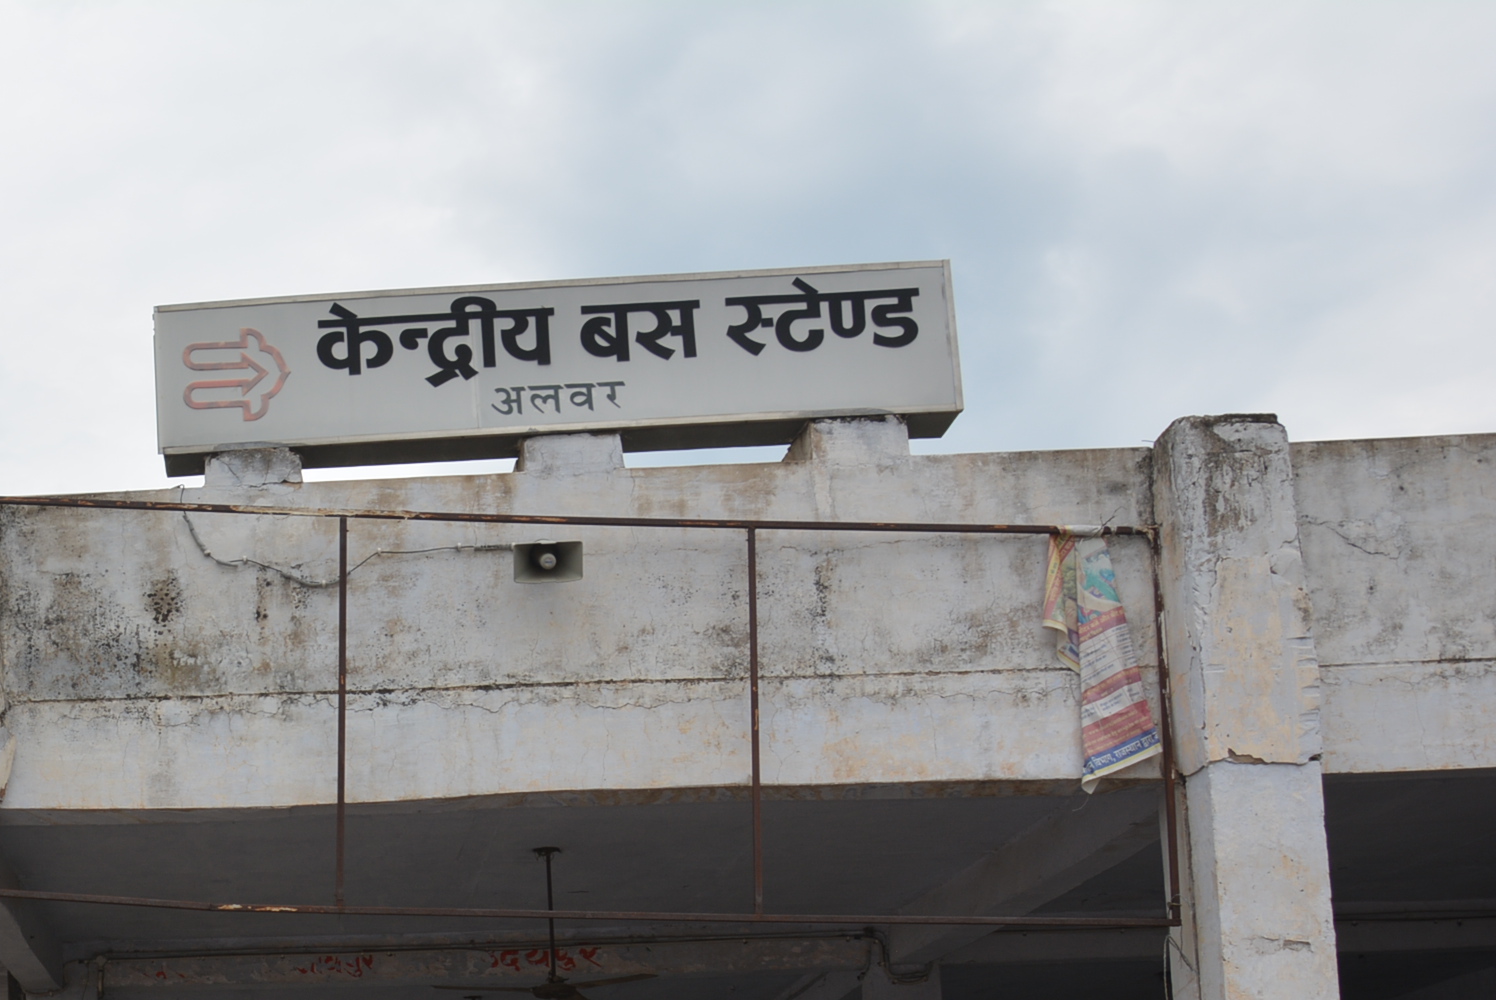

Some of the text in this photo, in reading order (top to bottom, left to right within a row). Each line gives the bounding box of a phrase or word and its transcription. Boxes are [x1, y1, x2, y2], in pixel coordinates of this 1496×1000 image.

[316, 276, 920, 387] केन्द्रीय बस स्टेण्ड
[491, 381, 626, 417] अलवर
